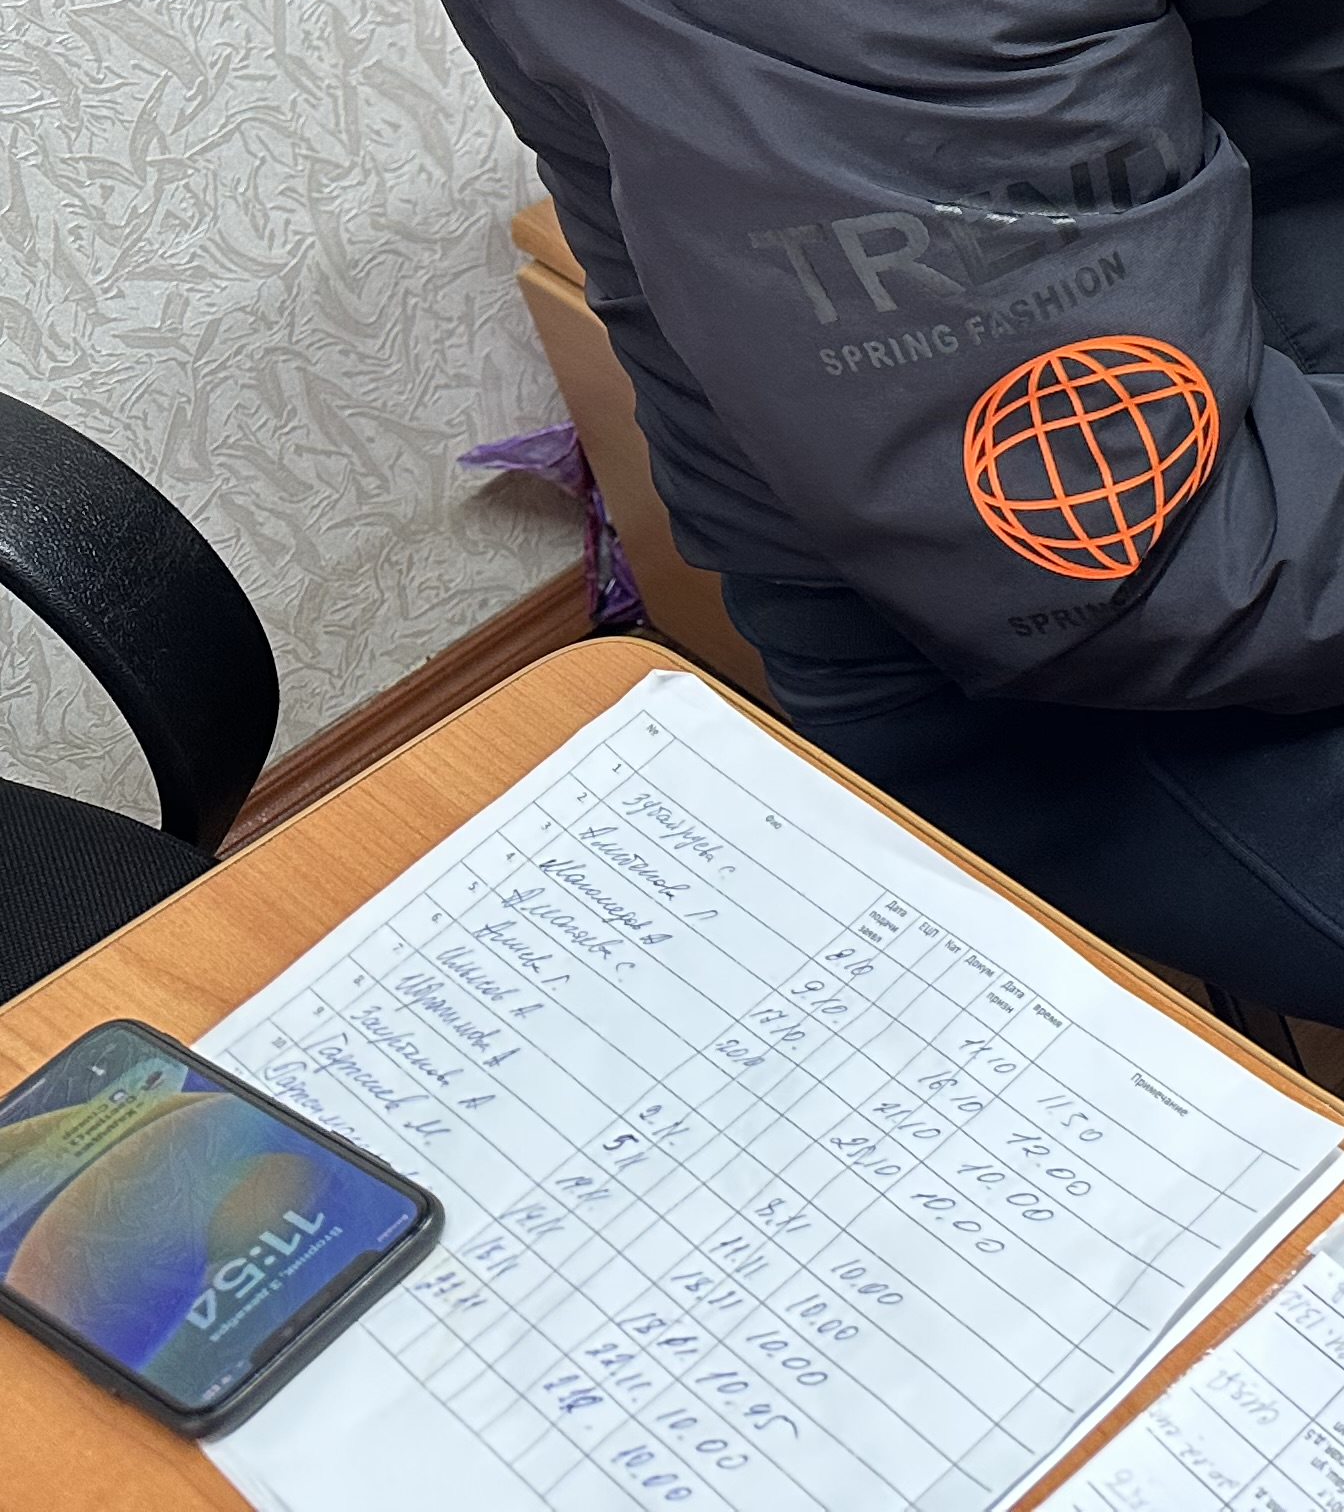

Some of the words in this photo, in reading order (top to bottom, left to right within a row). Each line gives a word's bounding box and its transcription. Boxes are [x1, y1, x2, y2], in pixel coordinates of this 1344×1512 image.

[818, 323, 961, 378] SPRING
[967, 250, 1129, 346] FASHION
[577, 792, 587, 803] 2.
[869, 911, 899, 932] подачи
[885, 900, 907, 917] Дата
[919, 922, 939, 937] ЕЦП
[945, 939, 961, 953] Кат
[964, 955, 995, 977] Докум
[1000, 981, 1024, 999] Дата
[1131, 1073, 1188, 1116] Примечание
[185, 1211, 325, 1329] 11:54
[279, 1226, 343, 1276] Вторник,
[210, 1288, 269, 1342] декабря
